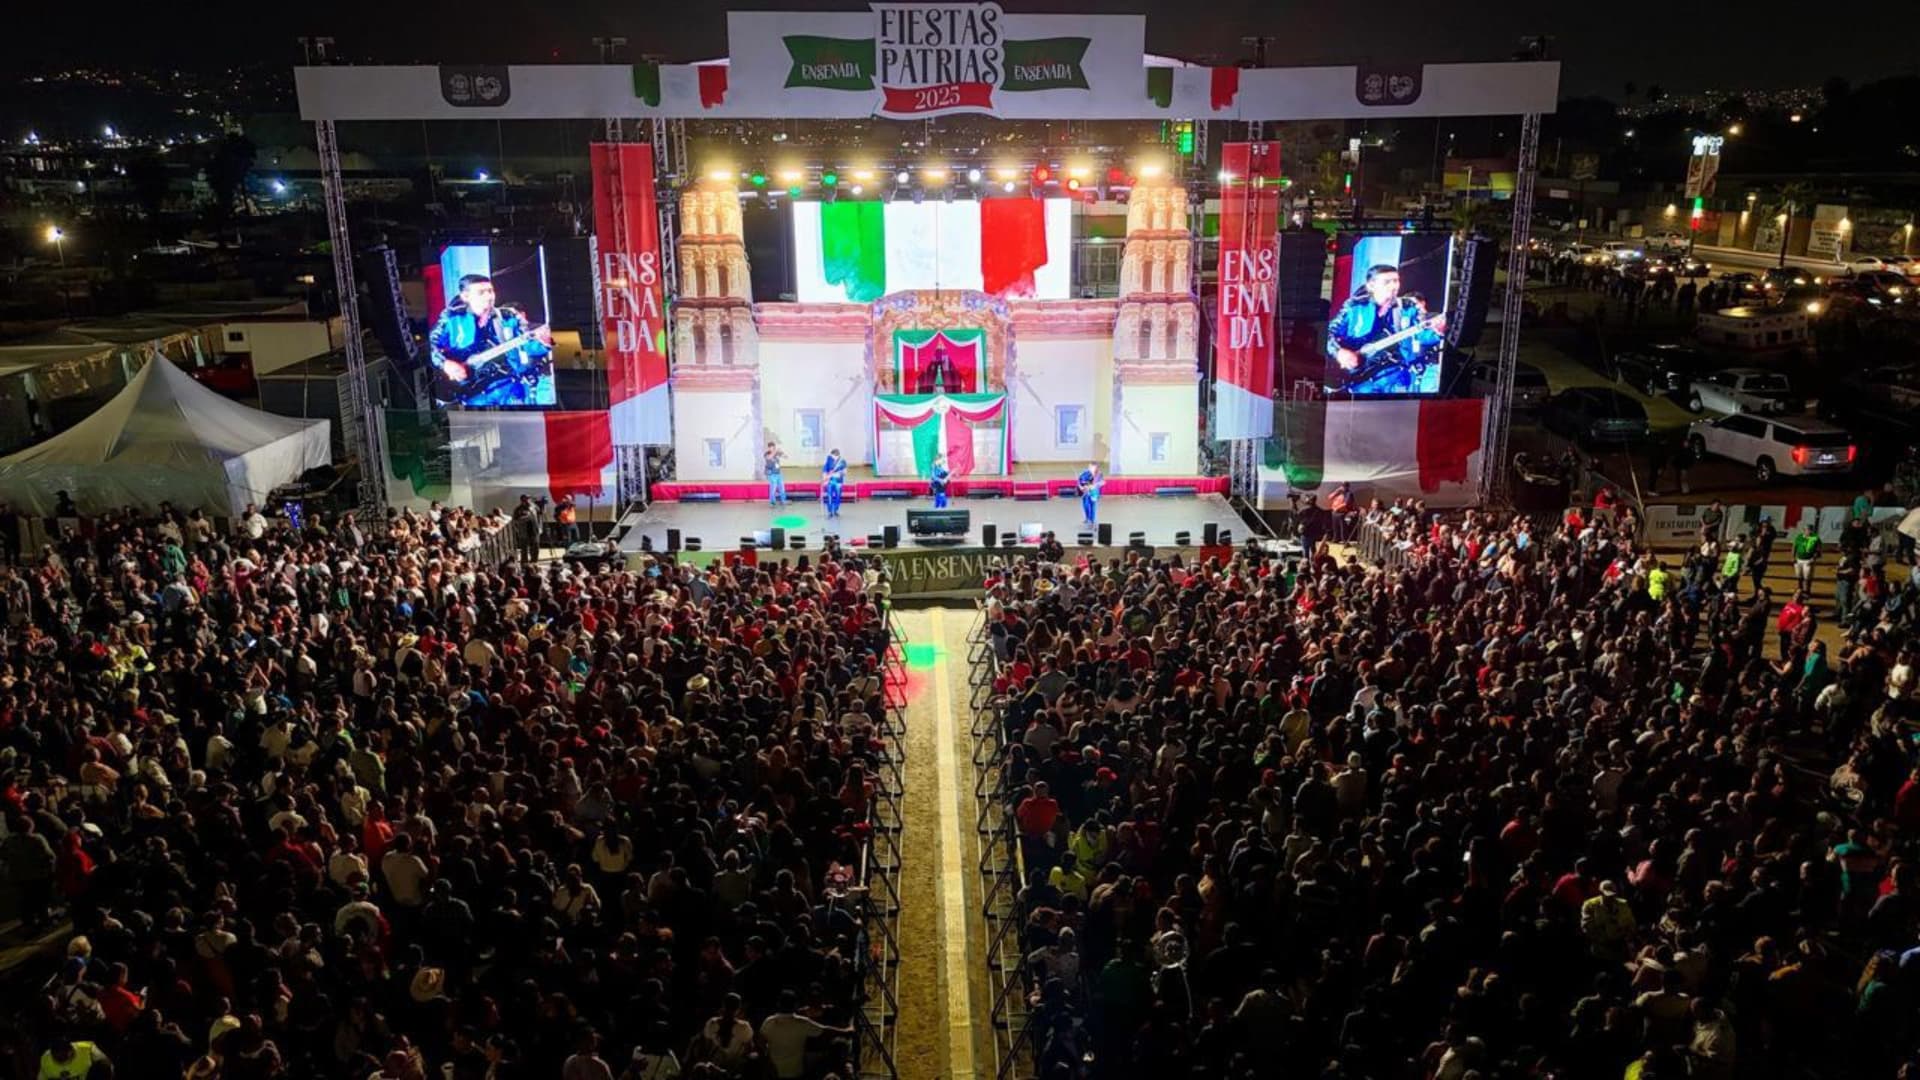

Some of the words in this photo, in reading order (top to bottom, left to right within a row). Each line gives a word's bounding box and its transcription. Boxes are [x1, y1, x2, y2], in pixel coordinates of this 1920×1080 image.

[881, 8, 998, 47] FIESTAS
[801, 62, 861, 81] ENSENADA
[881, 47, 999, 85] PATRIAS
[1014, 63, 1072, 82] ENSENADA
[915, 85, 961, 110] 2025
[604, 251, 657, 286] ENS
[1224, 248, 1273, 281] ENS
[606, 286, 659, 318] ENA
[1222, 282, 1270, 316] ENA
[617, 319, 655, 353] DA
[1230, 315, 1265, 350] DA
